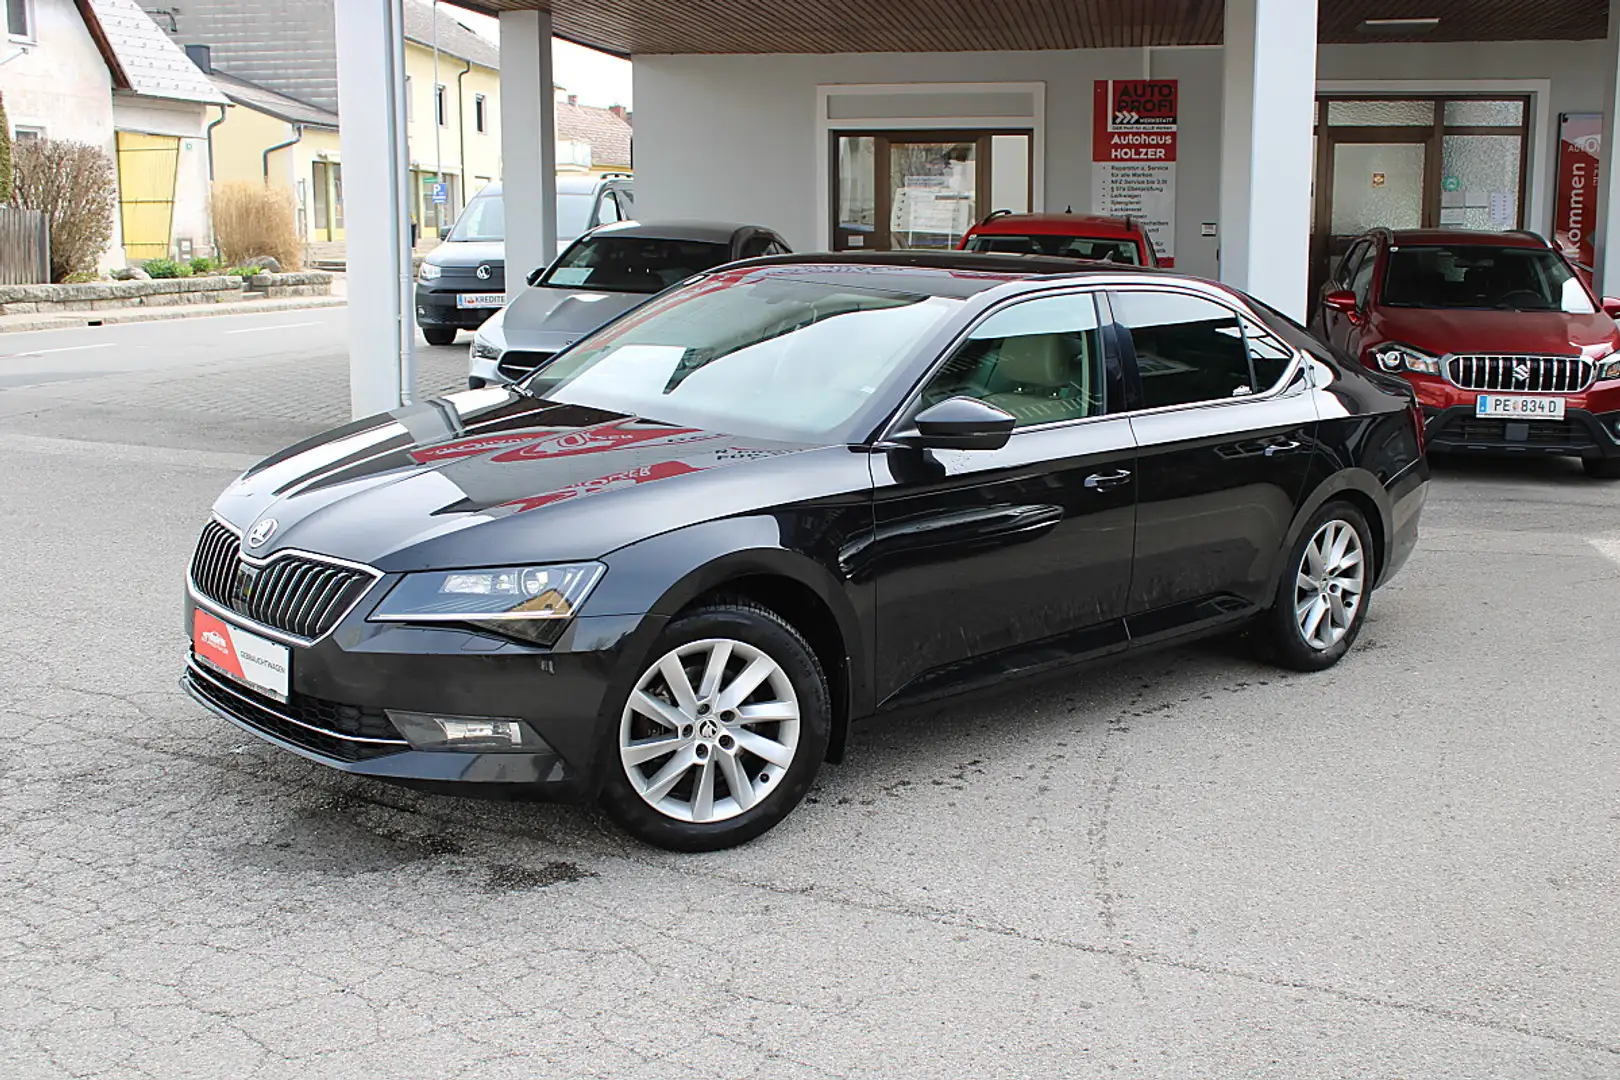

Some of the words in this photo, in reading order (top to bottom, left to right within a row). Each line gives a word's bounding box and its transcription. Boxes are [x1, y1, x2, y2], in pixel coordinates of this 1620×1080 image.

[1119, 84, 1174, 98] AUTO
[1118, 98, 1173, 112] PROFI
[1111, 133, 1172, 144] Autohaus
[1111, 148, 1165, 159] HOLZER
[1494, 398, 1511, 412] PE
[1521, 399, 1545, 413] 834
